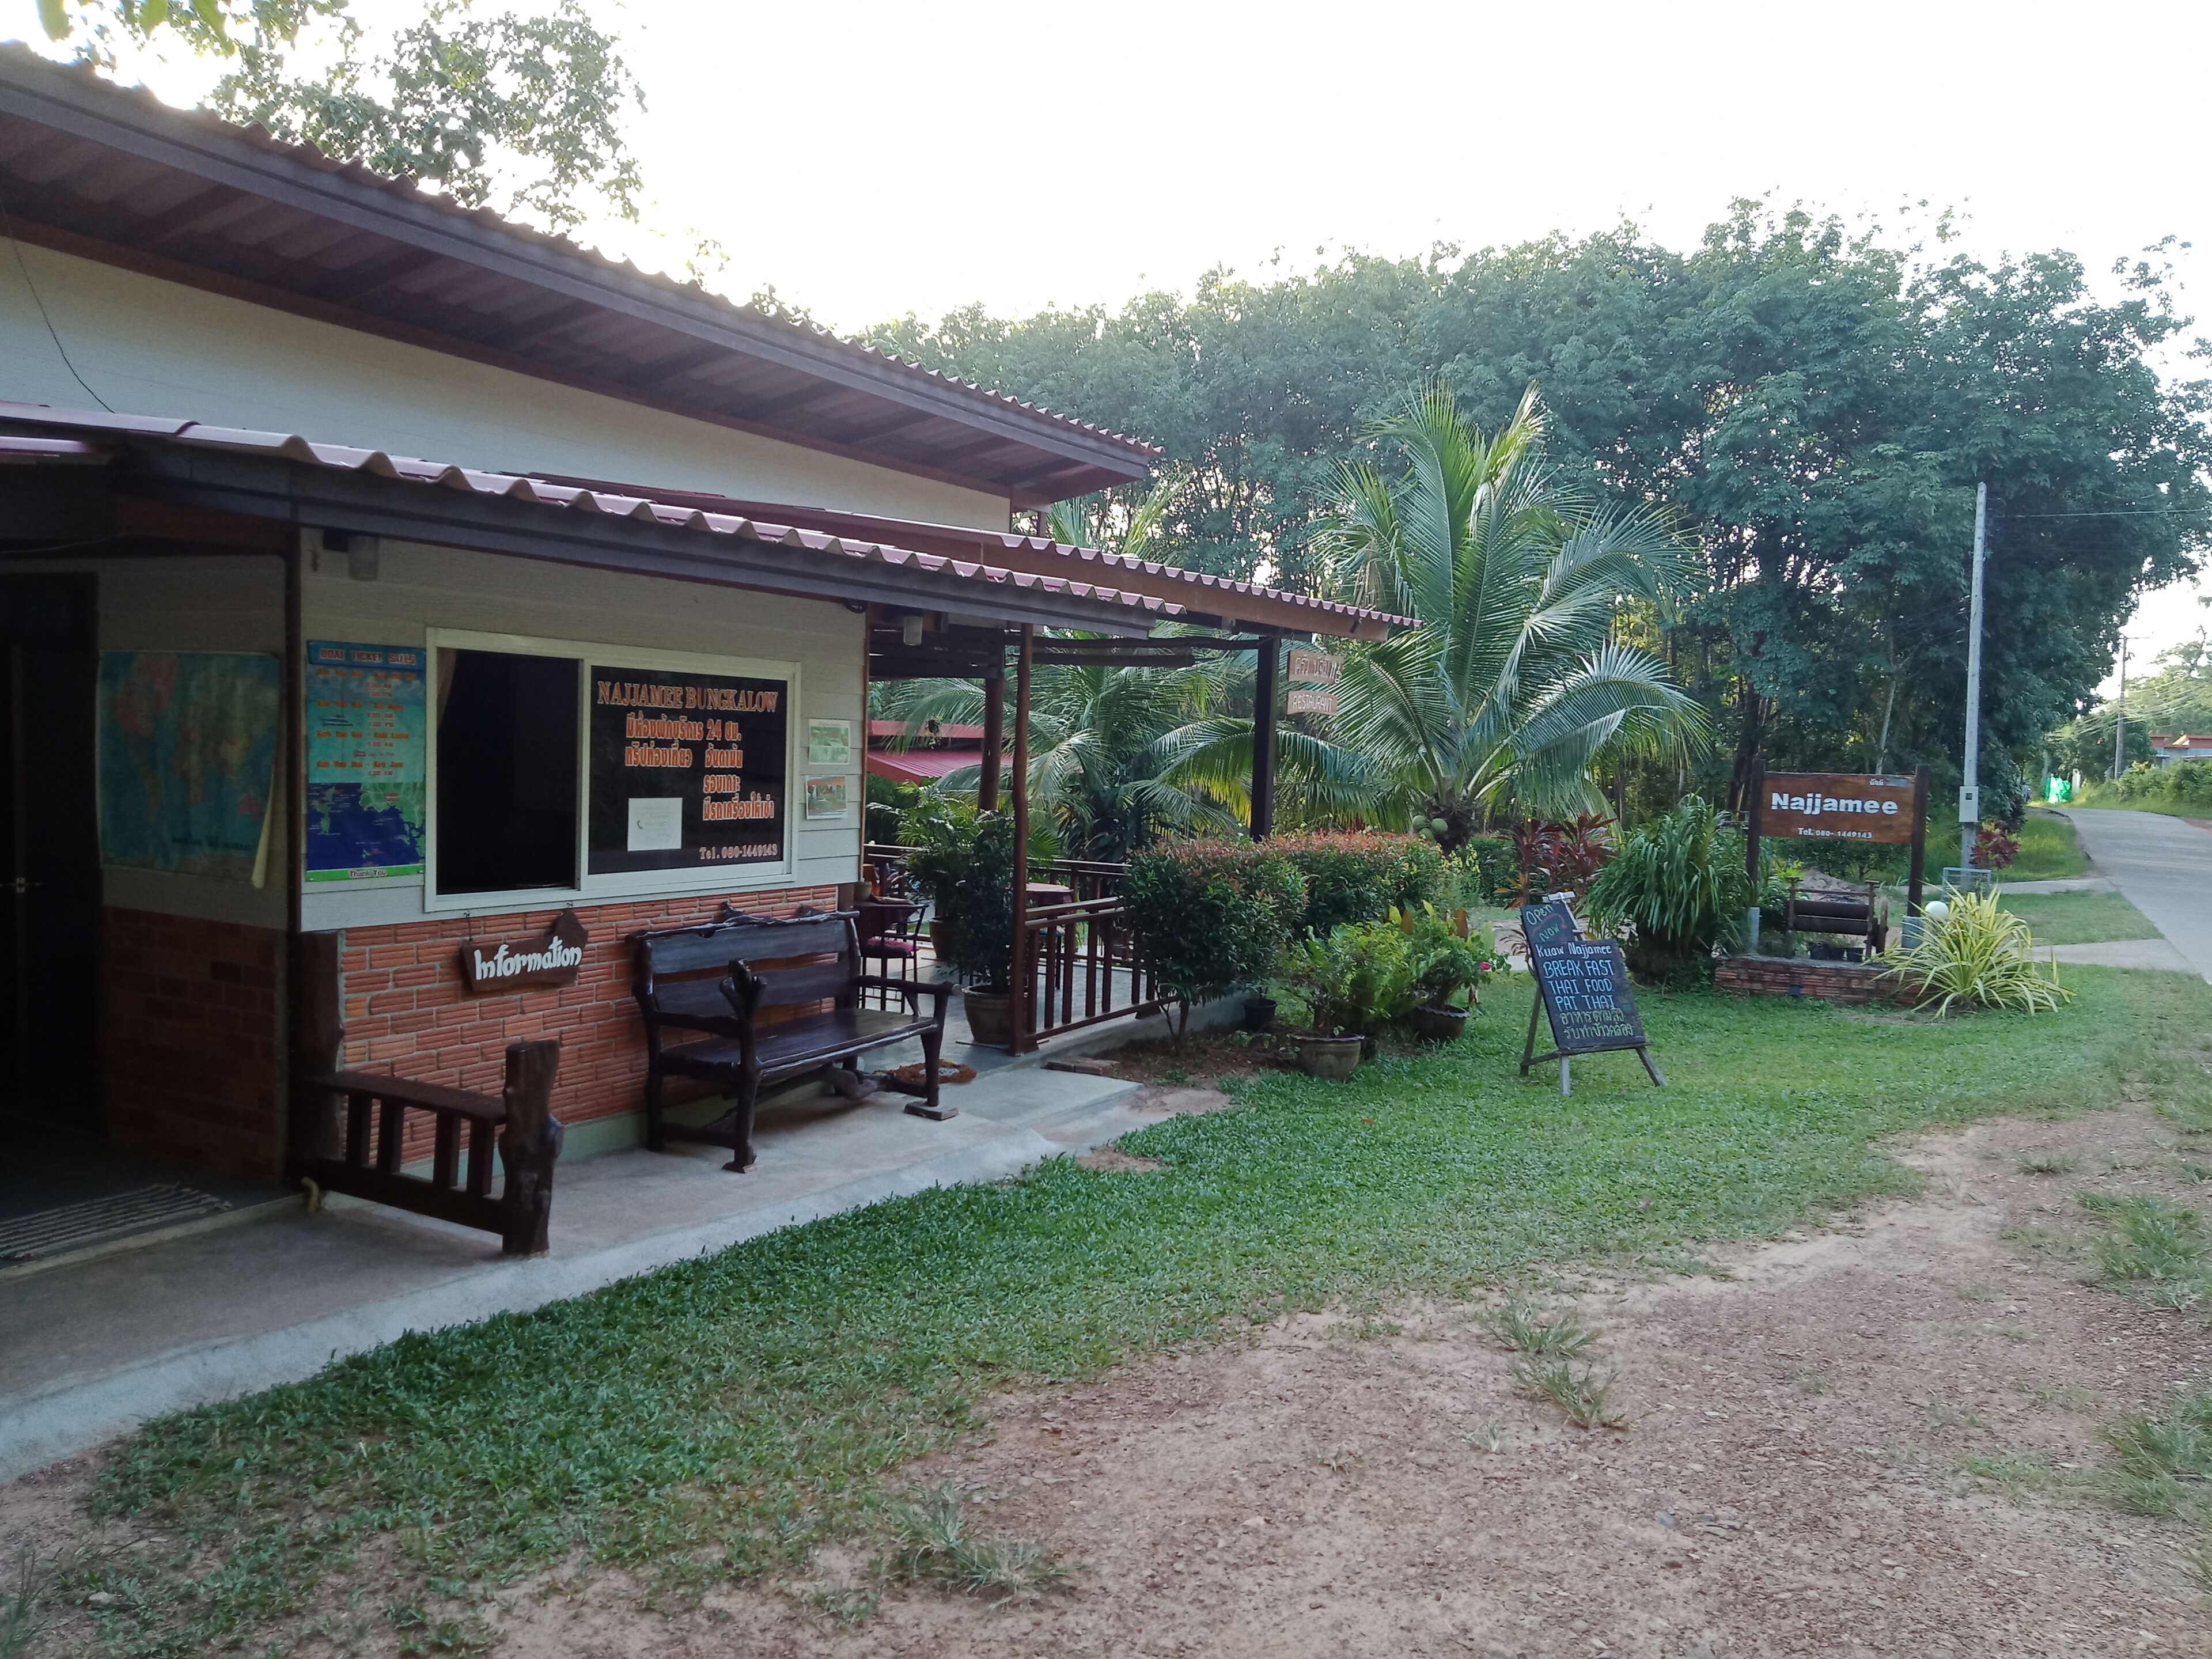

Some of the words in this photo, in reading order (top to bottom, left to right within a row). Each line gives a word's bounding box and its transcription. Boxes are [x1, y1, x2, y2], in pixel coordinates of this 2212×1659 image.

[350, 650, 382, 662] TICKET
[388, 653, 416, 665] SALES
[1294, 654, 1309, 675] ครัว
[597, 681, 683, 709] NAJJAMEE
[685, 687, 778, 713] BUNGKALOW
[1293, 694, 1333, 711] RESTAURANT
[706, 718, 722, 741] 24
[1771, 792, 1899, 815] Najjamee
[699, 846, 720, 860] Tel.
[350, 870, 370, 879] Thank
[1526, 904, 1554, 925] Open
[474, 935, 582, 980] Information
[1567, 942, 1612, 959] Najjamee
[1543, 959, 1584, 978] BREAK
[1548, 979, 1581, 995] THAI
[1581, 995, 1616, 1010] THAI
